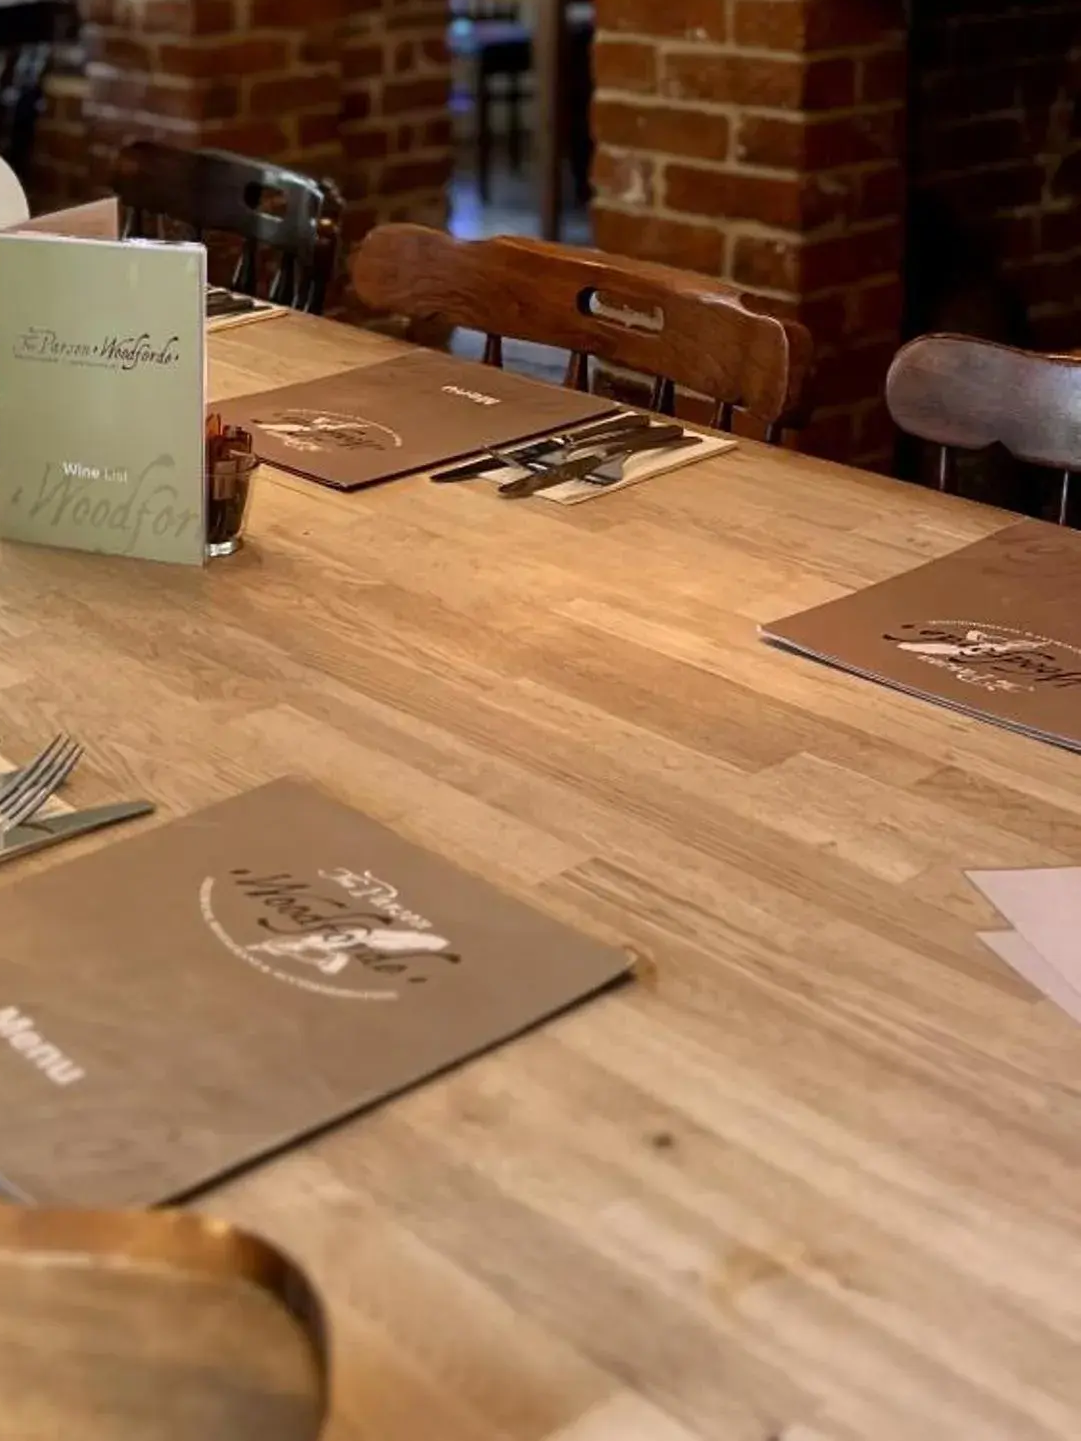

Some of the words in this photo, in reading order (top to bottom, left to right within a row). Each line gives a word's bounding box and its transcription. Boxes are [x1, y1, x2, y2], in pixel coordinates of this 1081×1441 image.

[29, 326, 91, 357] Parson
[62, 461, 101, 480] Wine
[103, 468, 129, 485] List
[28, 453, 201, 555] Woodfor
